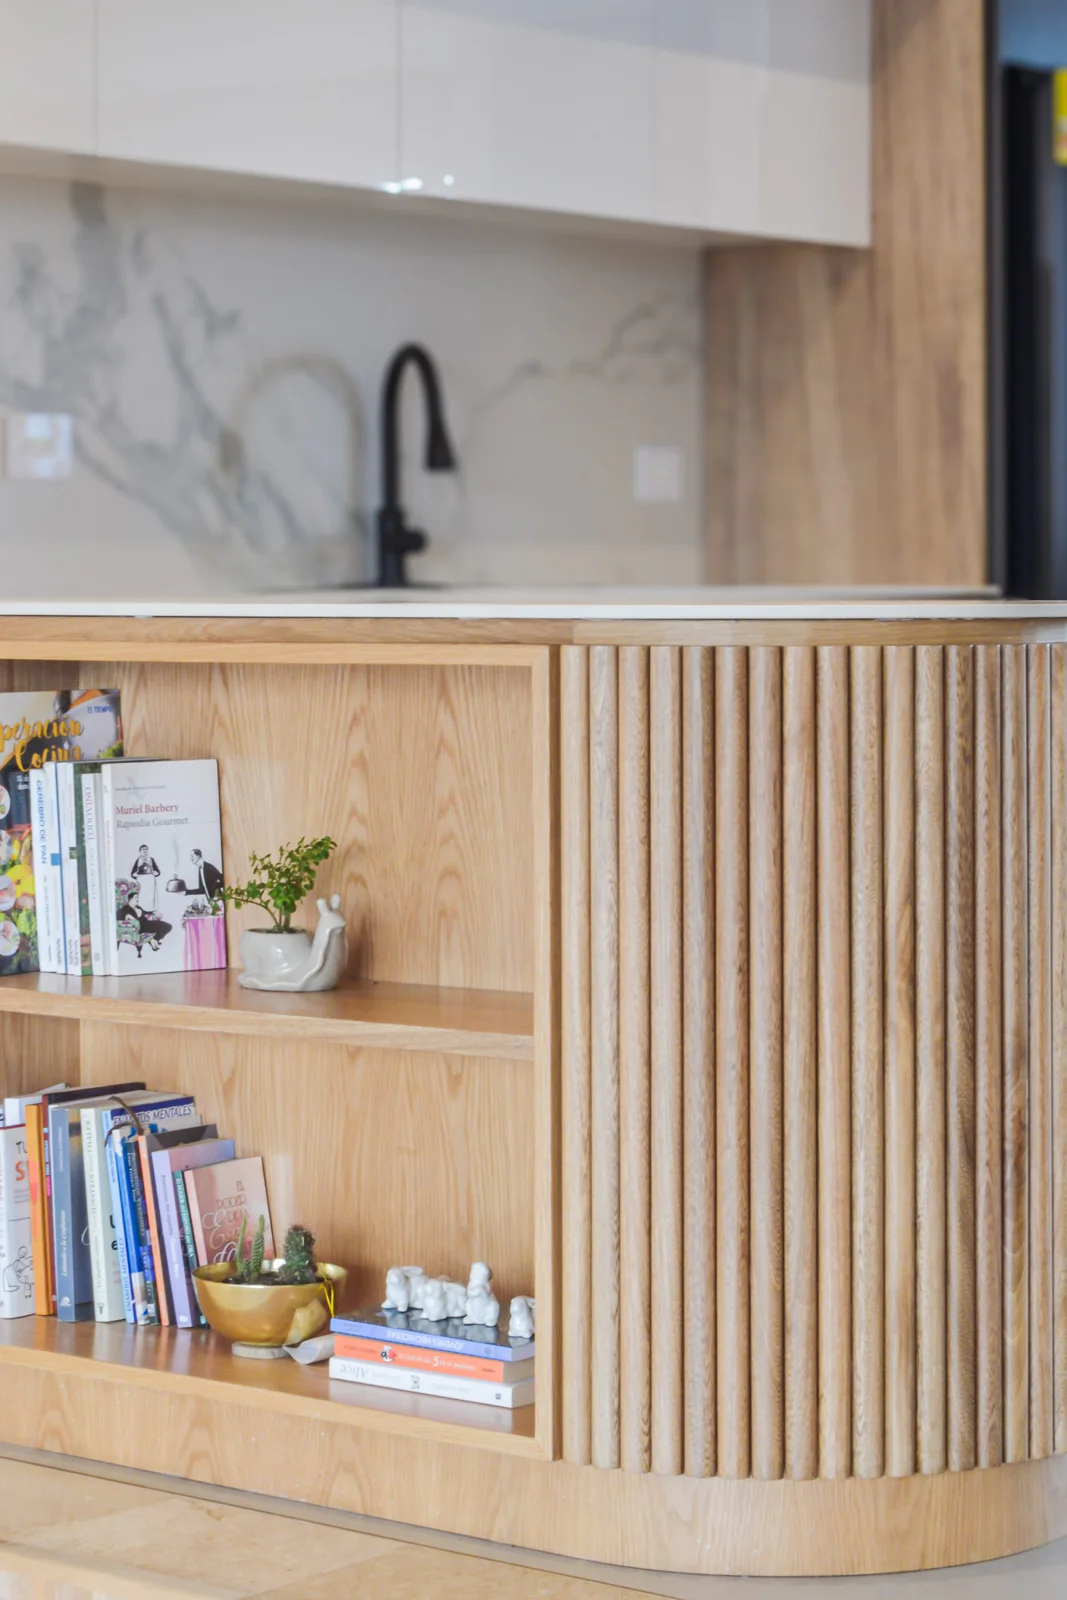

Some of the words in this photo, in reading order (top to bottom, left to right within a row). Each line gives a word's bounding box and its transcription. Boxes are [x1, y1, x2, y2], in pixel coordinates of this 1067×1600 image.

[0, 715, 84, 753] peración
[36, 779, 46, 827] CEREBRO
[116, 804, 143, 815] Muriel
[145, 803, 179, 814] Barbery
[116, 818, 151, 830] Rapsodia
[152, 817, 189, 827] Gourmet
[40, 829, 46, 839] DE
[40, 845, 48, 864] PAN
[152, 1104, 192, 1120] MENTALES
[340, 1364, 367, 1379] Alice
